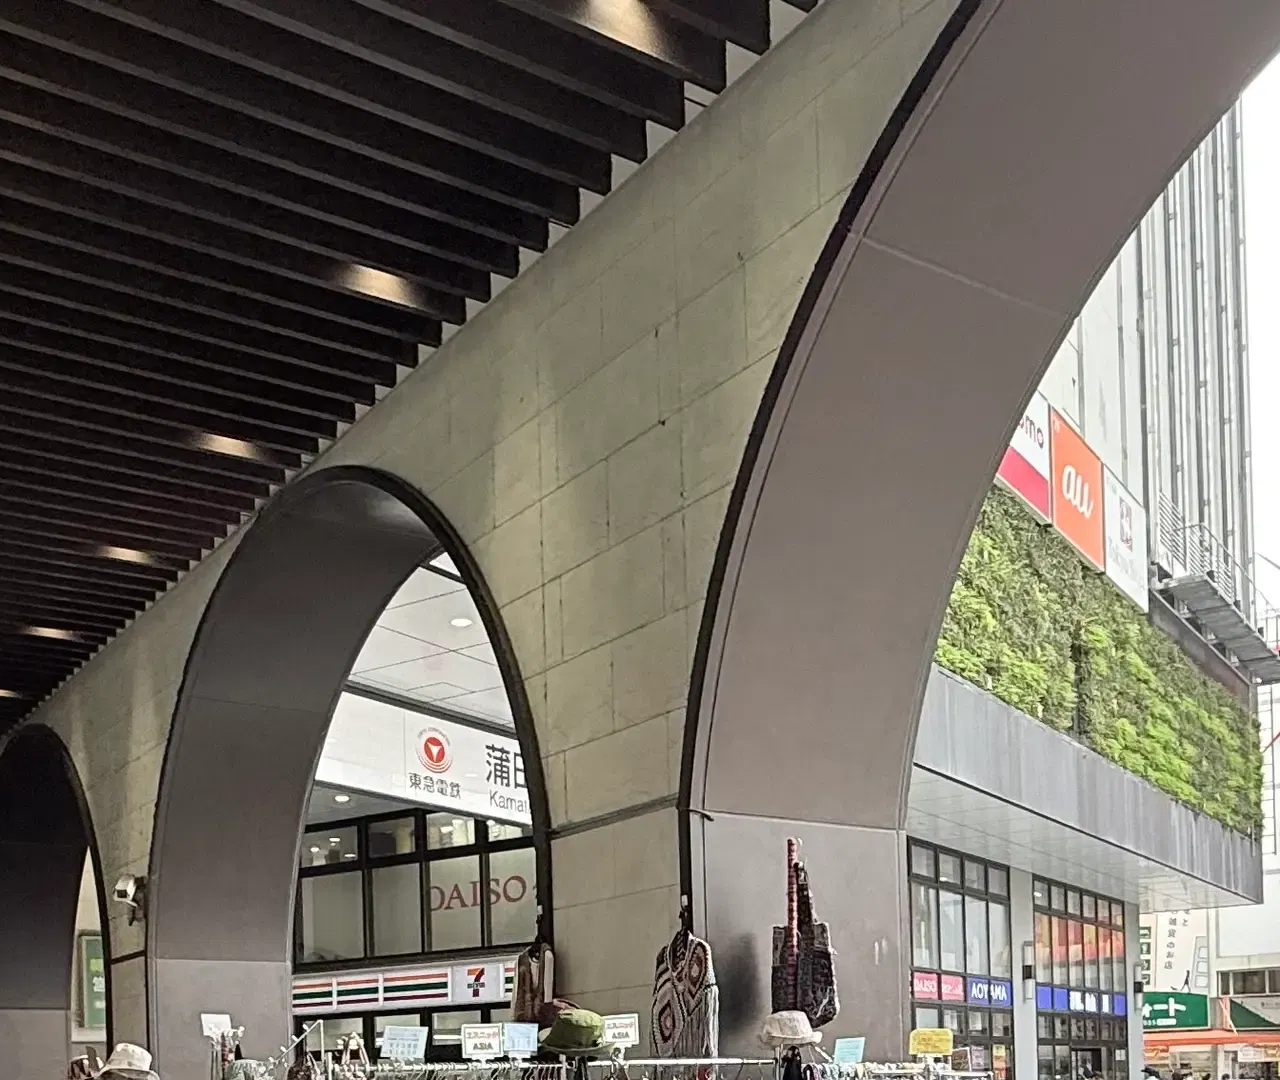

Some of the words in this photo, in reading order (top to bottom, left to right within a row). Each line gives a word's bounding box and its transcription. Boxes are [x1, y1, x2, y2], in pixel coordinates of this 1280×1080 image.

[1062, 464, 1094, 520] au
[409, 772, 461, 799] 東急電鉄
[429, 875, 527, 913] DAISO
[971, 982, 1007, 1001] AOYAMA
[473, 1042, 493, 1051] ASIA
